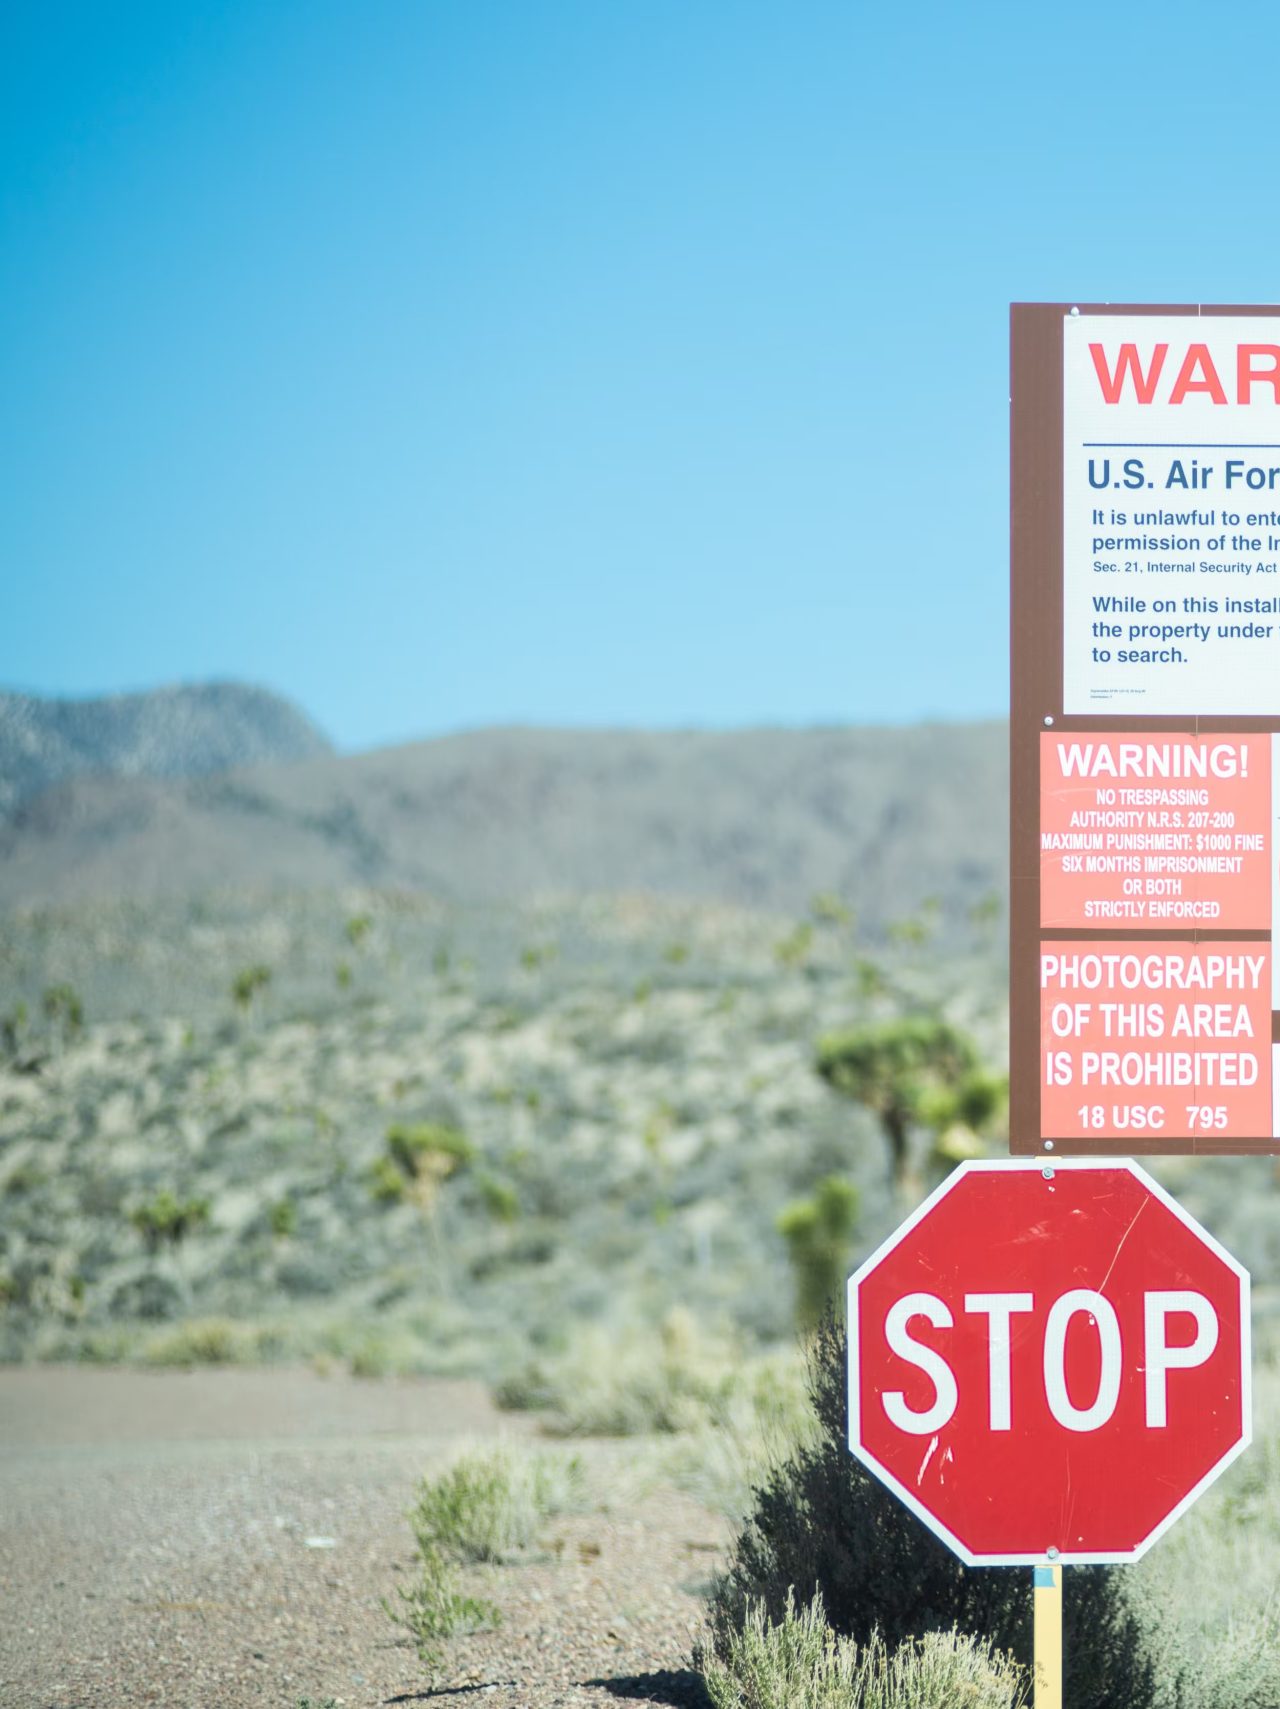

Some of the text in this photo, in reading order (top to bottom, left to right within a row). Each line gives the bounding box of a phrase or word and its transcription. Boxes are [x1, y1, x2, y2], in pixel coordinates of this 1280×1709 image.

[1089, 459, 1153, 489] U.S.
[1166, 460, 1213, 489] Air
[1092, 509, 1105, 525] It
[1111, 509, 1126, 525] is
[1134, 510, 1214, 525] unlawful
[1222, 511, 1240, 525] to
[1093, 535, 1199, 554] permission
[1207, 535, 1225, 550] of
[1232, 535, 1261, 550] the
[1093, 561, 1120, 573] Sec.
[1148, 562, 1195, 572] Internal
[1200, 562, 1251, 575] Security
[1256, 563, 1277, 572] Act
[1093, 597, 1146, 612] While
[1153, 601, 1176, 612] on
[1183, 597, 1218, 612] this
[1092, 622, 1122, 637] the
[1130, 623, 1210, 641] property
[1218, 623, 1273, 638] under
[1092, 647, 1187, 662] to search.
[1057, 744, 1247, 778] WARNING!
[1097, 789, 1208, 805] NO TRESPASSING
[1070, 811, 1234, 828] AUTHORITY N.R.S. 207-200
[1042, 833, 1263, 852] MAXIMUM PUNISHMENT: $1000 FINE
[1063, 856, 1243, 872] SIX MONTHS IMPRISONMENT
[1123, 879, 1181, 895] OR BOTH
[1085, 901, 1220, 917] STRICTLY ENFORCED
[1042, 955, 1265, 988] PHOTOGRAPHY
[1052, 1003, 1254, 1037] OF THIS AREA
[1047, 1052, 1258, 1085] IS PROHIBITED
[1079, 1106, 1228, 1128] 18 USC 795
[882, 1288, 1219, 1435] STOP
